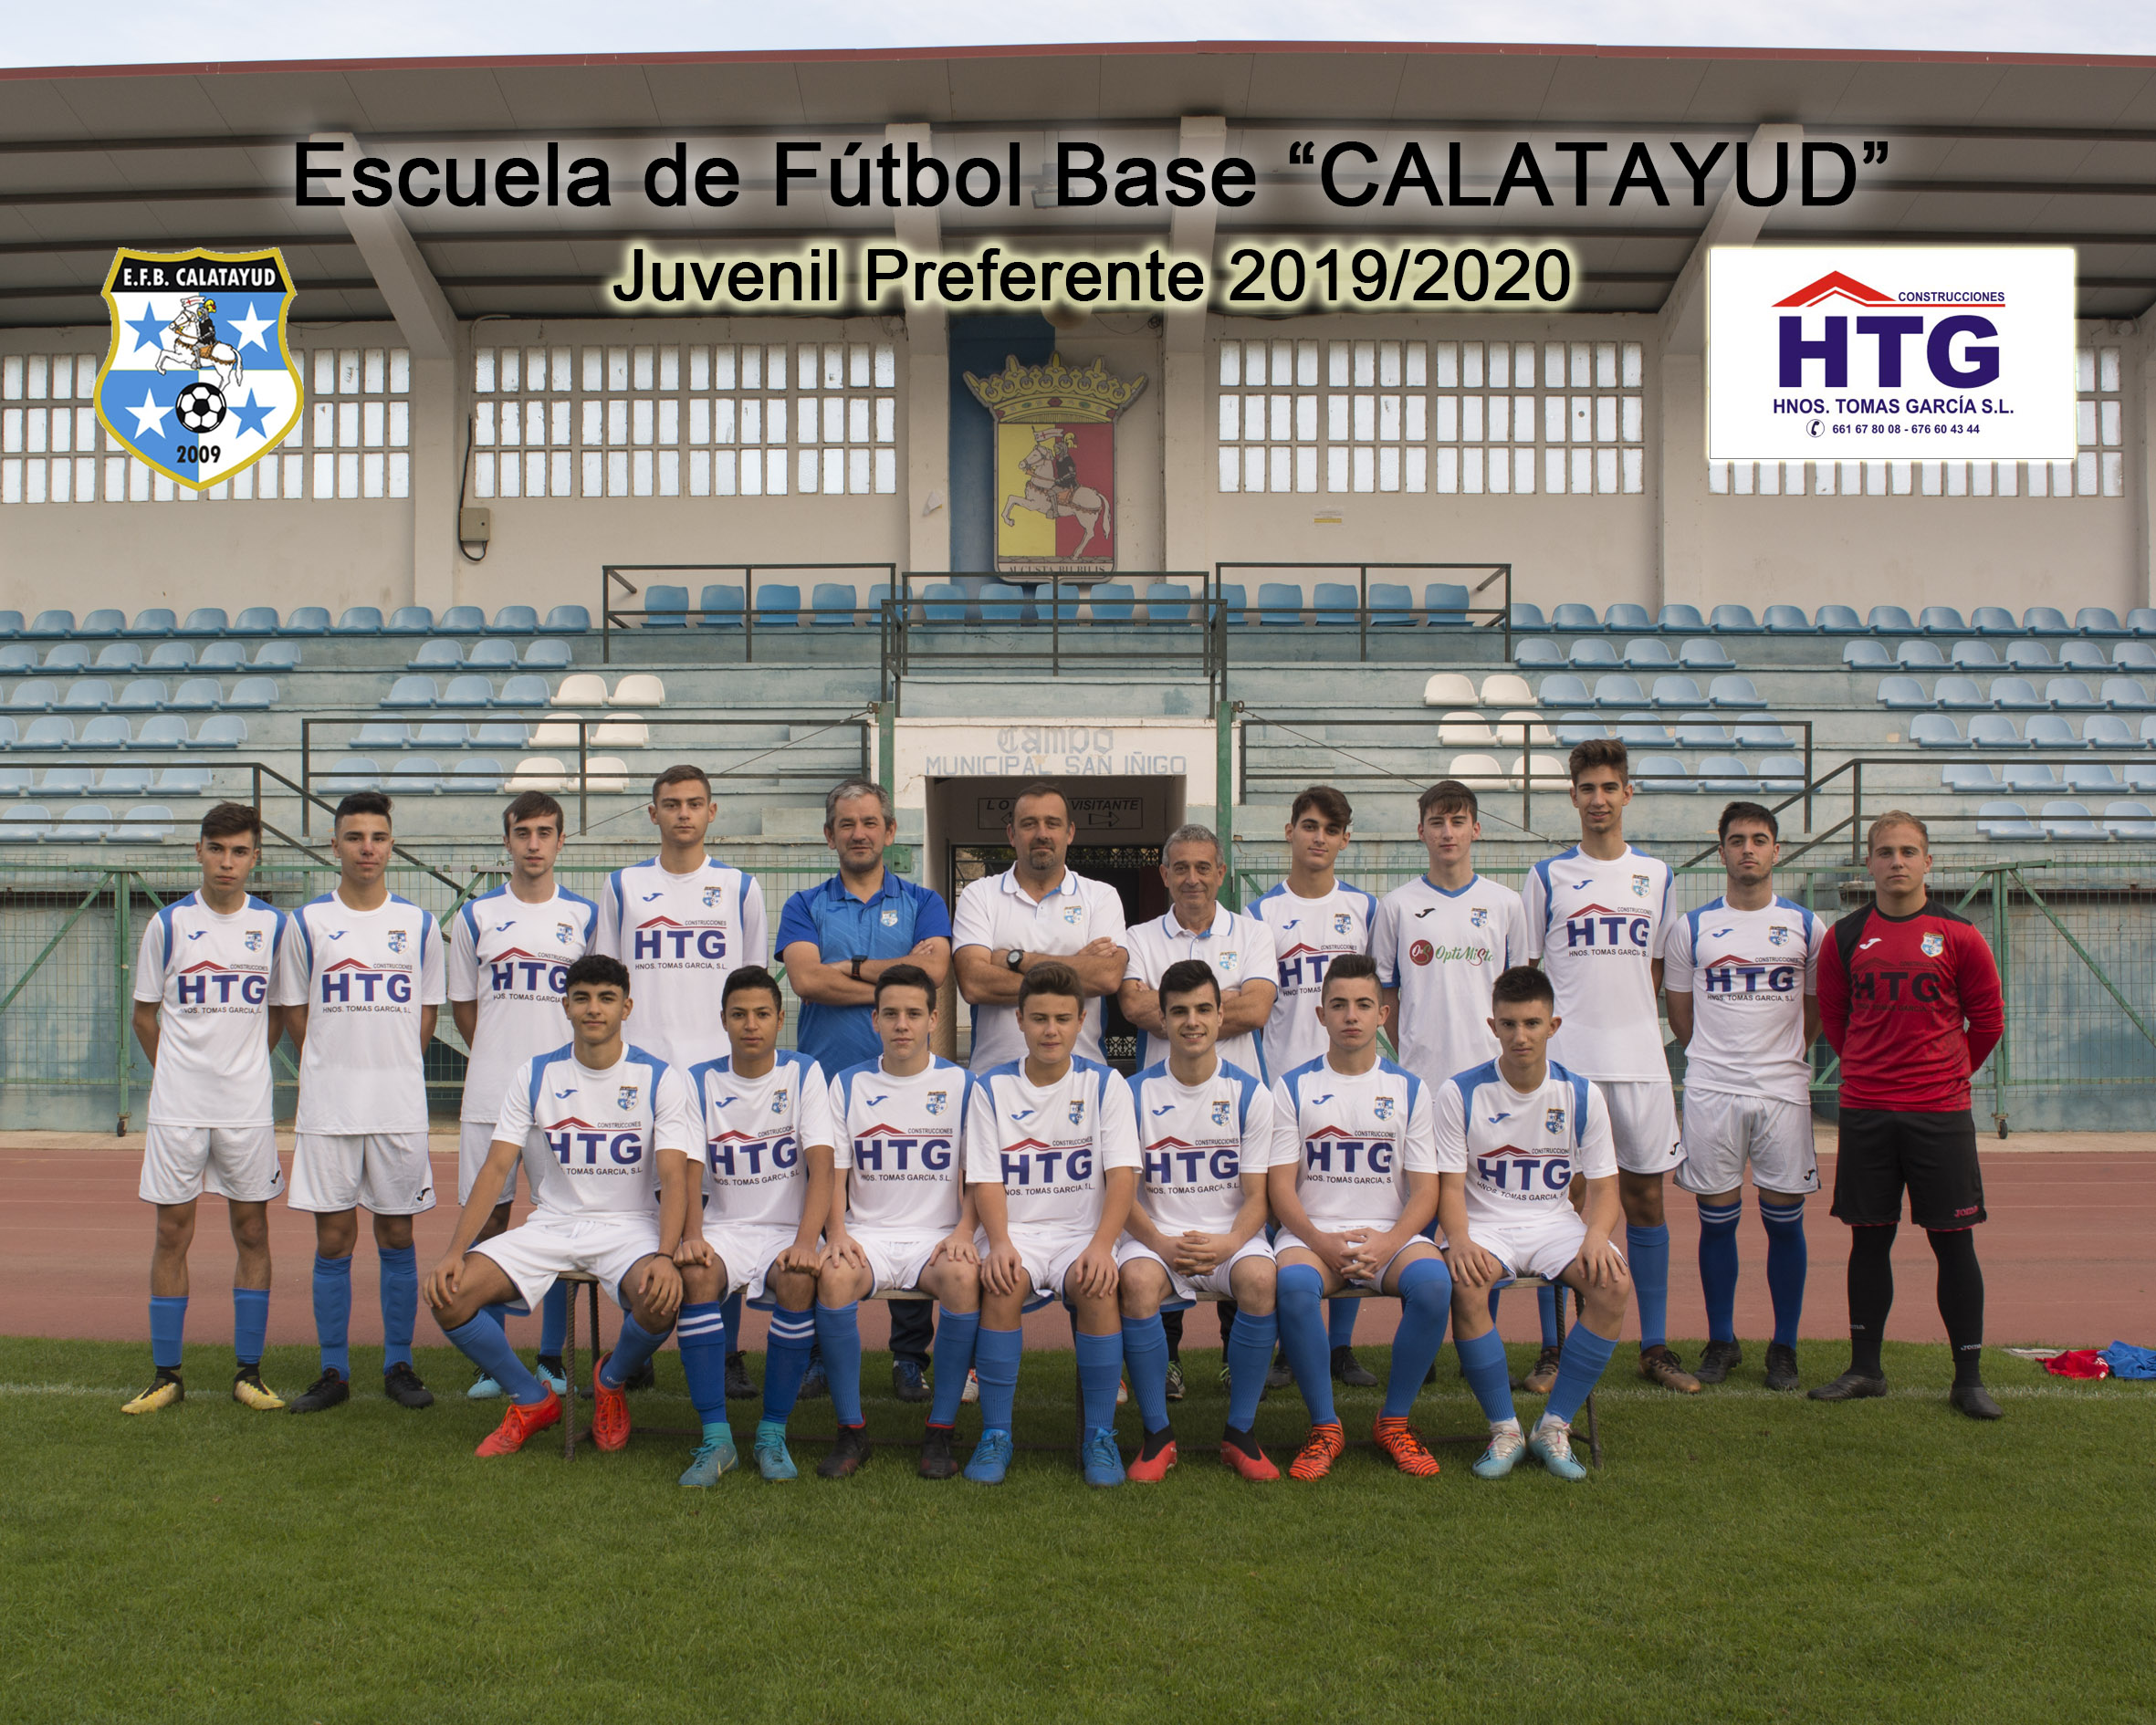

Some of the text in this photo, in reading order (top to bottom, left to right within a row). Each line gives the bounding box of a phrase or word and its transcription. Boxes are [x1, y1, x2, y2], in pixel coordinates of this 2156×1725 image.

[926, 751, 1187, 776] MUNICIPAL SAN IÑIGO
[1071, 800, 1139, 810] VISITANTE
[634, 930, 726, 959] HTG
[1566, 917, 1650, 947] HTG
[491, 961, 567, 994] HTG
[1278, 955, 1328, 988] HT
[1705, 967, 1795, 992] HTG
[178, 974, 267, 1005] HTG
[322, 973, 412, 1003] HTG
[1300, 986, 1322, 994] TOMAS
[1853, 971, 1941, 1003] HTG
[597, 1121, 642, 1129] CONSTRUCCIONES
[545, 1132, 642, 1165] HTG
[707, 1136, 798, 1176] HTG
[854, 1138, 951, 1171] HTG
[1195, 1137, 1240, 1146] CONSTRUCCIONES
[1000, 1148, 1092, 1185] HTG
[1145, 1149, 1240, 1184] HTG
[1305, 1141, 1393, 1174] HTG
[1326, 1176, 1353, 1184] TOMAS
[1477, 1157, 1571, 1190] HTG
[1026, 1187, 1052, 1196] TOMAS
[1501, 1191, 1527, 1201] TOMAS
